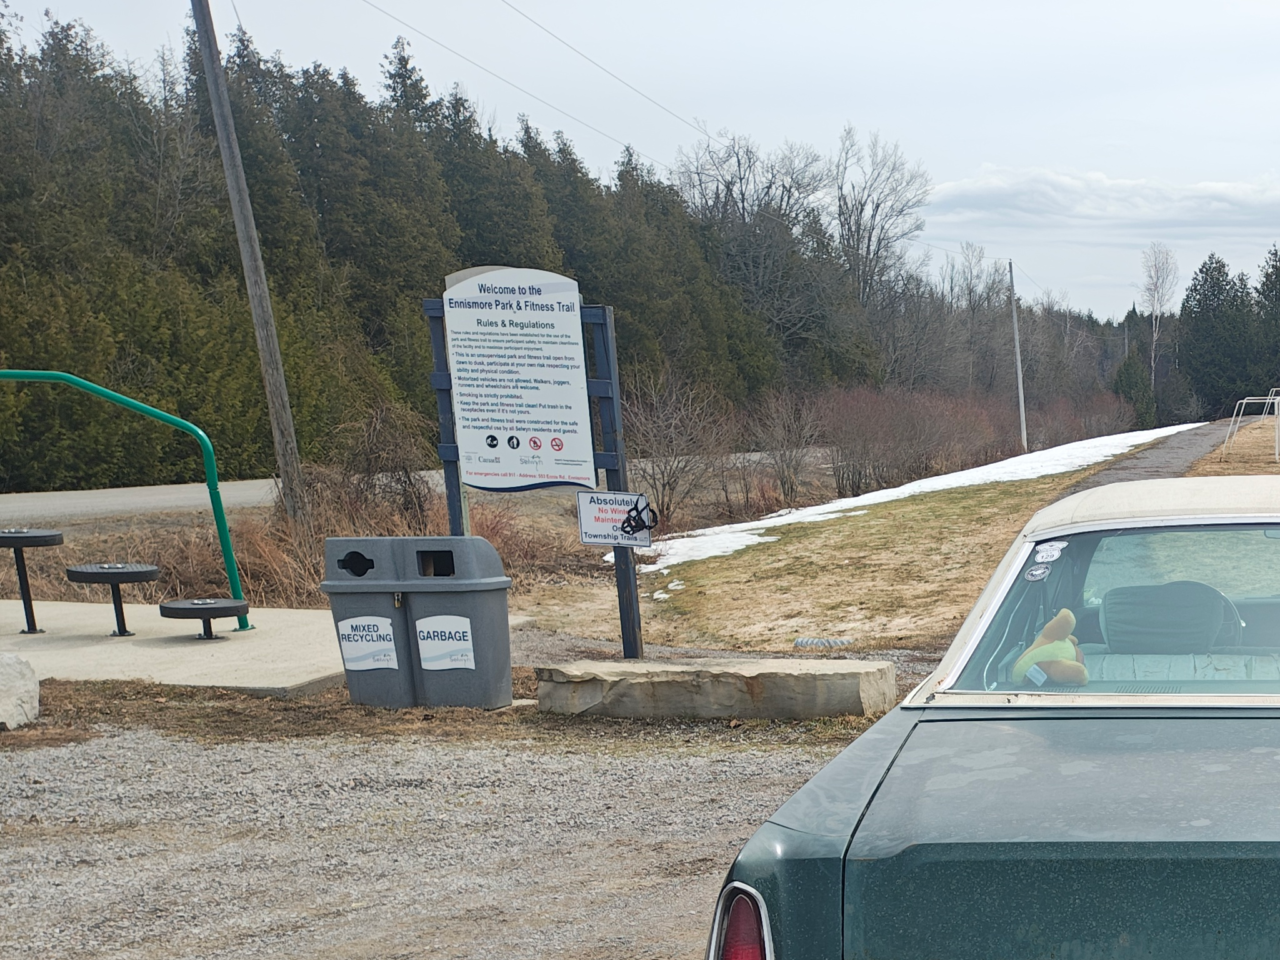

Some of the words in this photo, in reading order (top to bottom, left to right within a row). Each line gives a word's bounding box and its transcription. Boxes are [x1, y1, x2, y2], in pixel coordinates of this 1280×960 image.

[478, 283, 516, 295] Welcome
[518, 285, 526, 295] to
[528, 285, 542, 296] the
[448, 298, 493, 309] Ennismore
[494, 299, 513, 310] Park
[516, 300, 522, 311] &
[524, 300, 555, 312] Fitness
[556, 301, 575, 313] Trail
[476, 319, 499, 328] Rules
[500, 320, 507, 328] &
[508, 320, 555, 330] Regulations
[479, 367, 497, 375] physical
[478, 455, 501, 464] Canada
[589, 495, 637, 507] Absolutely
[610, 507, 630, 515] Winte
[583, 531, 619, 541] Township
[620, 533, 638, 542] Trails
[350, 624, 380, 633] MIXED
[341, 633, 393, 643] RECYCLING
[418, 630, 469, 642] GARBAGE
